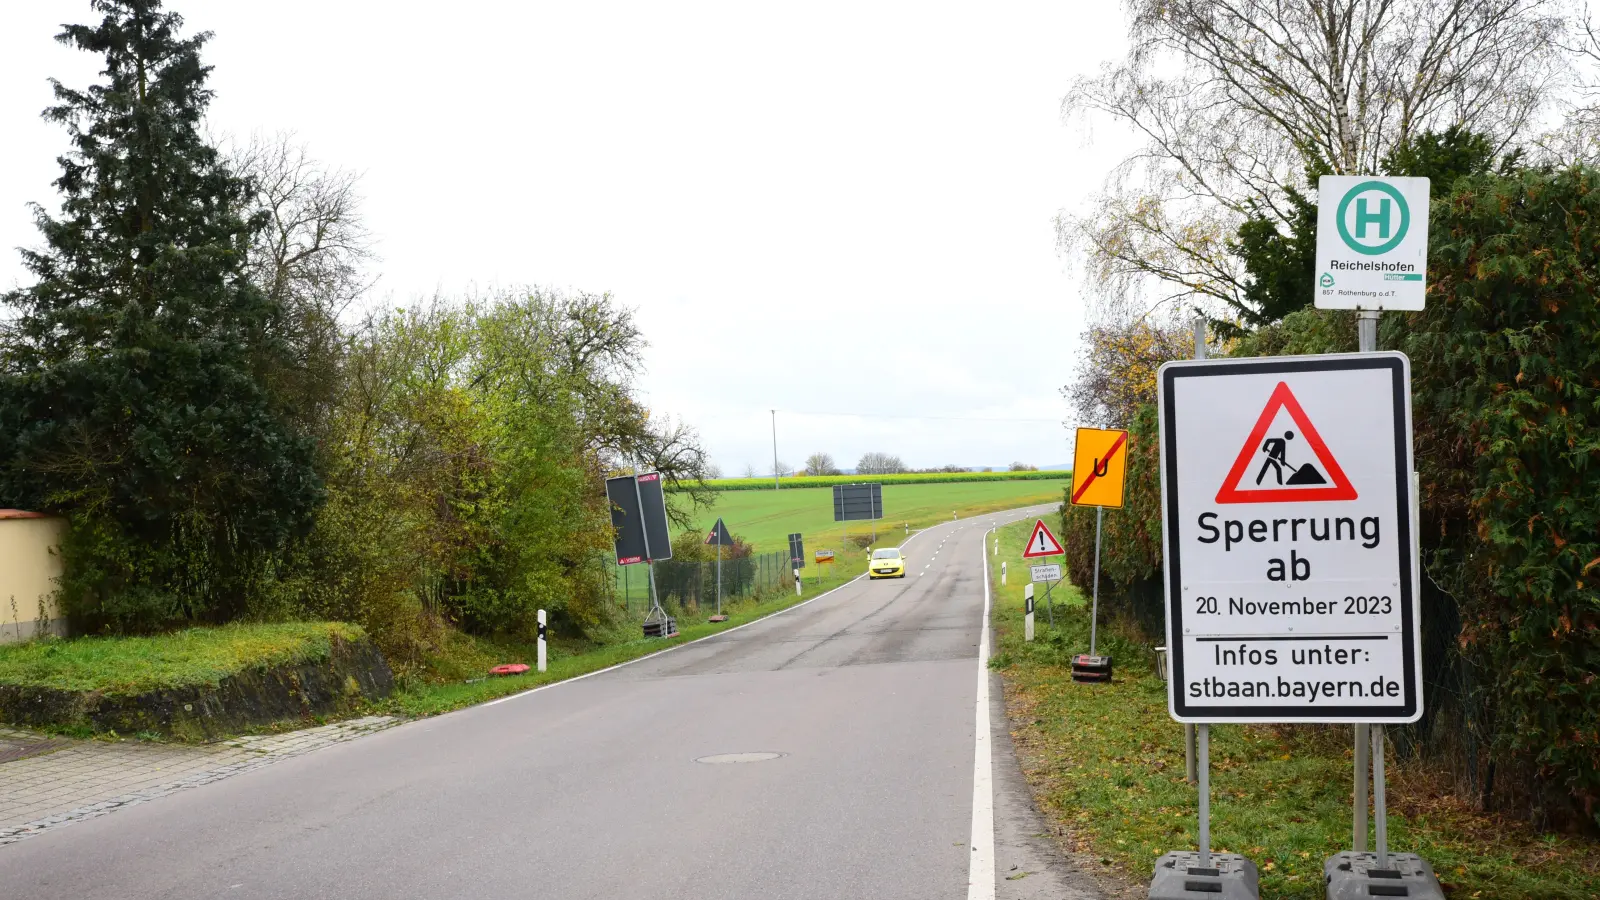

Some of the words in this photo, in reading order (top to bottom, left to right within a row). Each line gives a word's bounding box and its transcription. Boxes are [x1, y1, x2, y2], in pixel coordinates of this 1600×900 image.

[1355, 198, 1391, 239] H
[1330, 260, 1415, 272] Reichelshofen
[1338, 289, 1377, 298] Rothenburg
[1093, 457, 1109, 478] U
[1197, 511, 1381, 552] Sperrung
[1266, 549, 1311, 582] ab
[1195, 596, 1221, 616] 20.
[1228, 596, 1338, 615] November
[1343, 596, 1392, 615] 2023
[1214, 643, 1278, 666] Infos
[1291, 644, 1370, 666] unter:
[1189, 675, 1400, 703] stbaan.bayern.de
